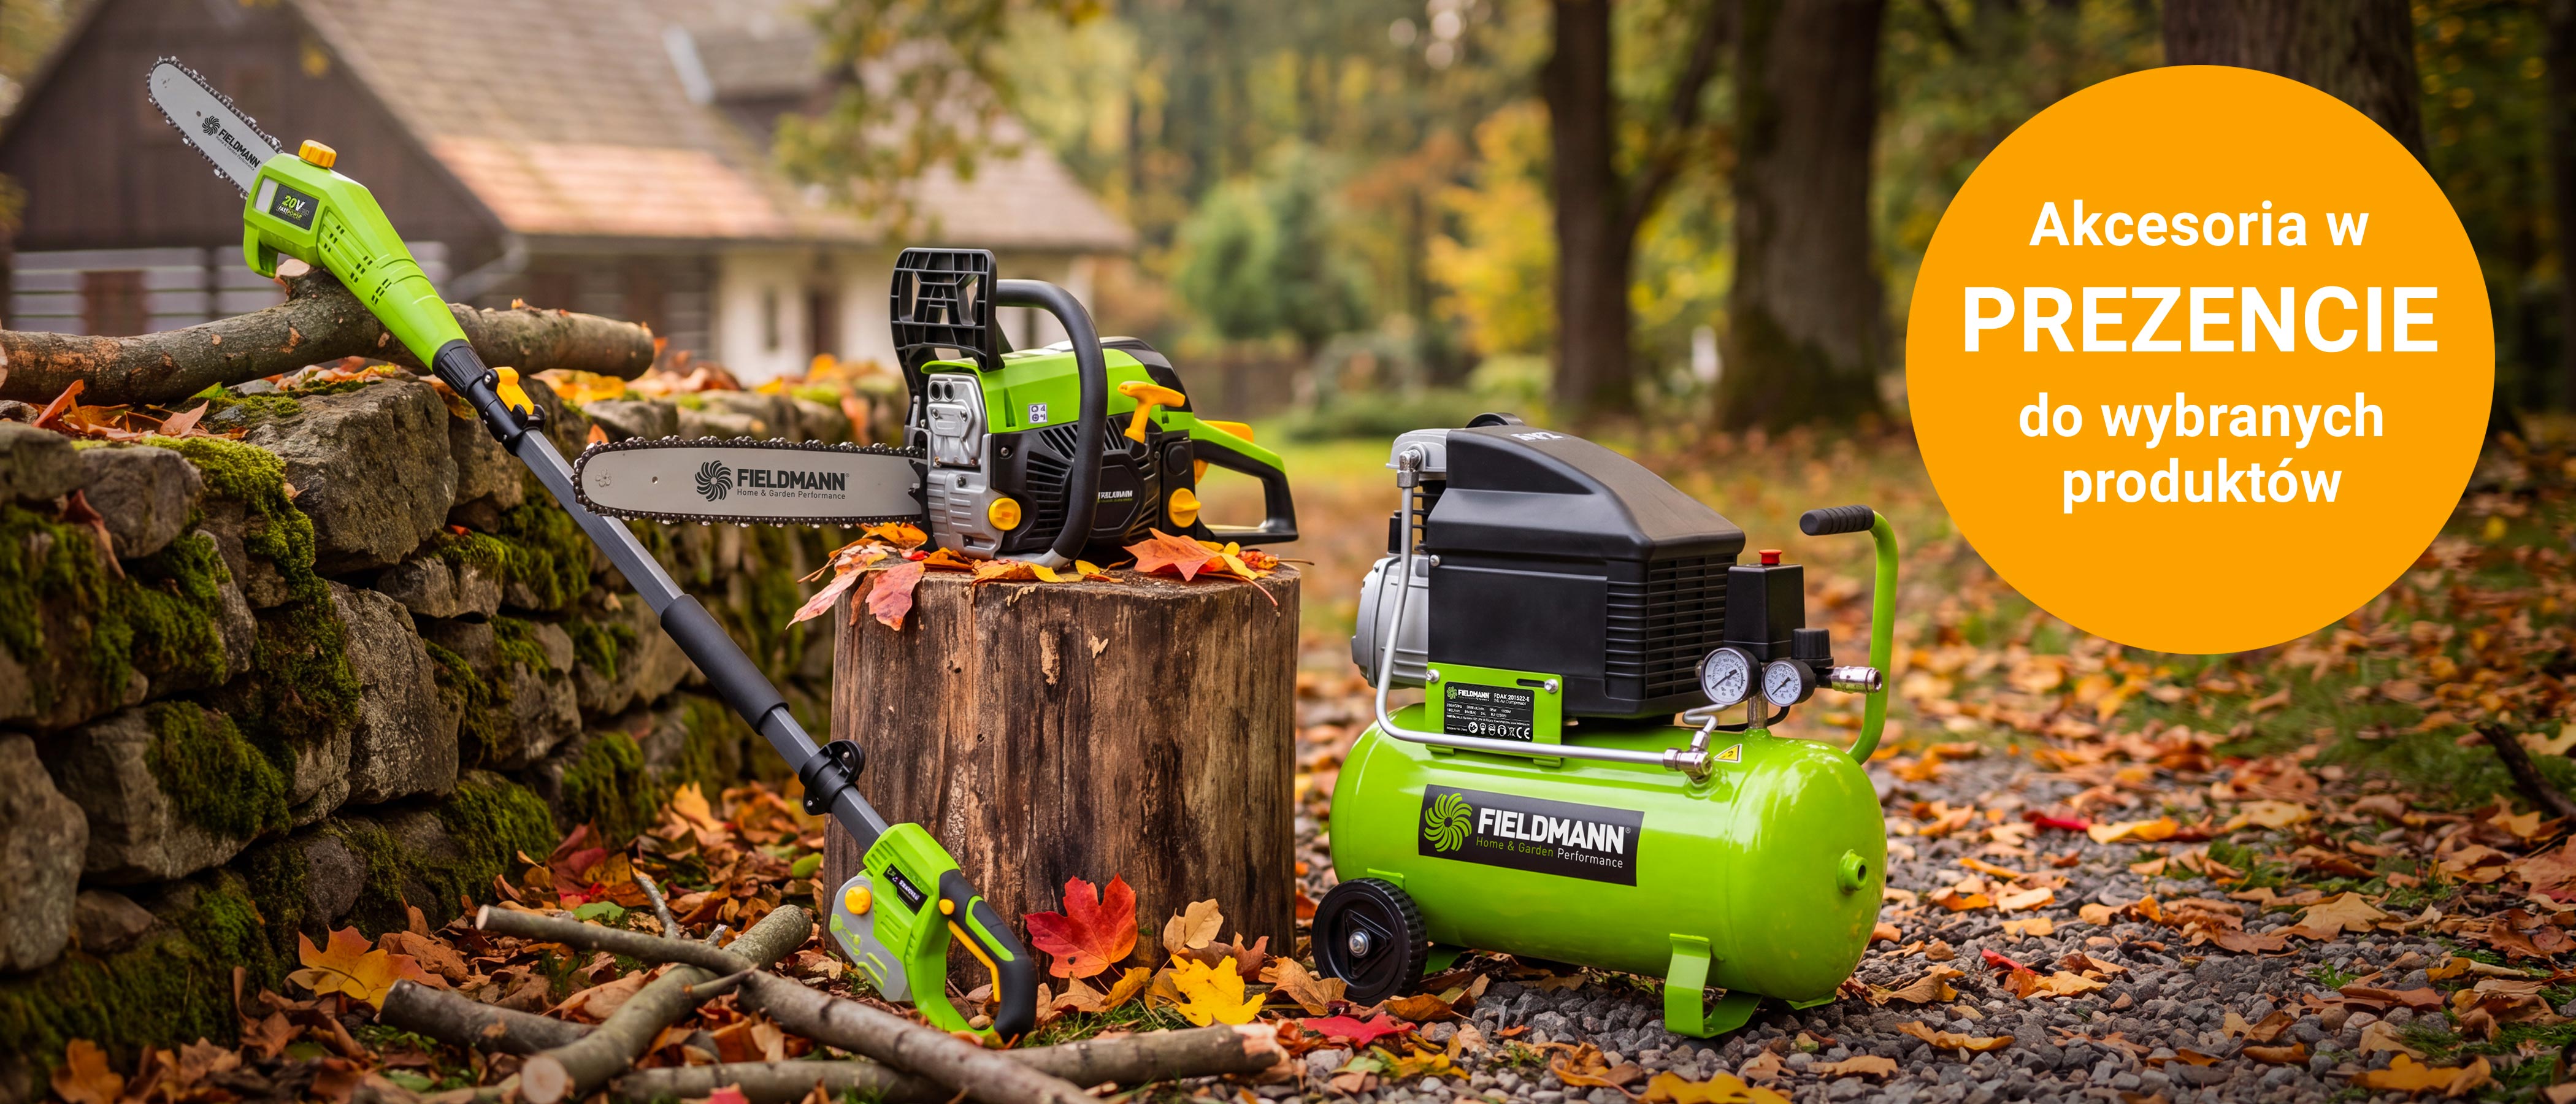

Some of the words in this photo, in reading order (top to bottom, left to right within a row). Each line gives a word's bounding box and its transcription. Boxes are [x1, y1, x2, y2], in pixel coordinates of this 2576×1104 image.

[218, 128, 261, 168] FIELDMANN
[282, 195, 305, 212] 20V
[798, 491, 846, 499] Performance
[1458, 689, 1490, 699] FIELDMANN
[1476, 836, 1504, 849] Home
[1508, 840, 1515, 851] &
[1518, 842, 1554, 857] Garden
[1557, 848, 1623, 868] Performance
